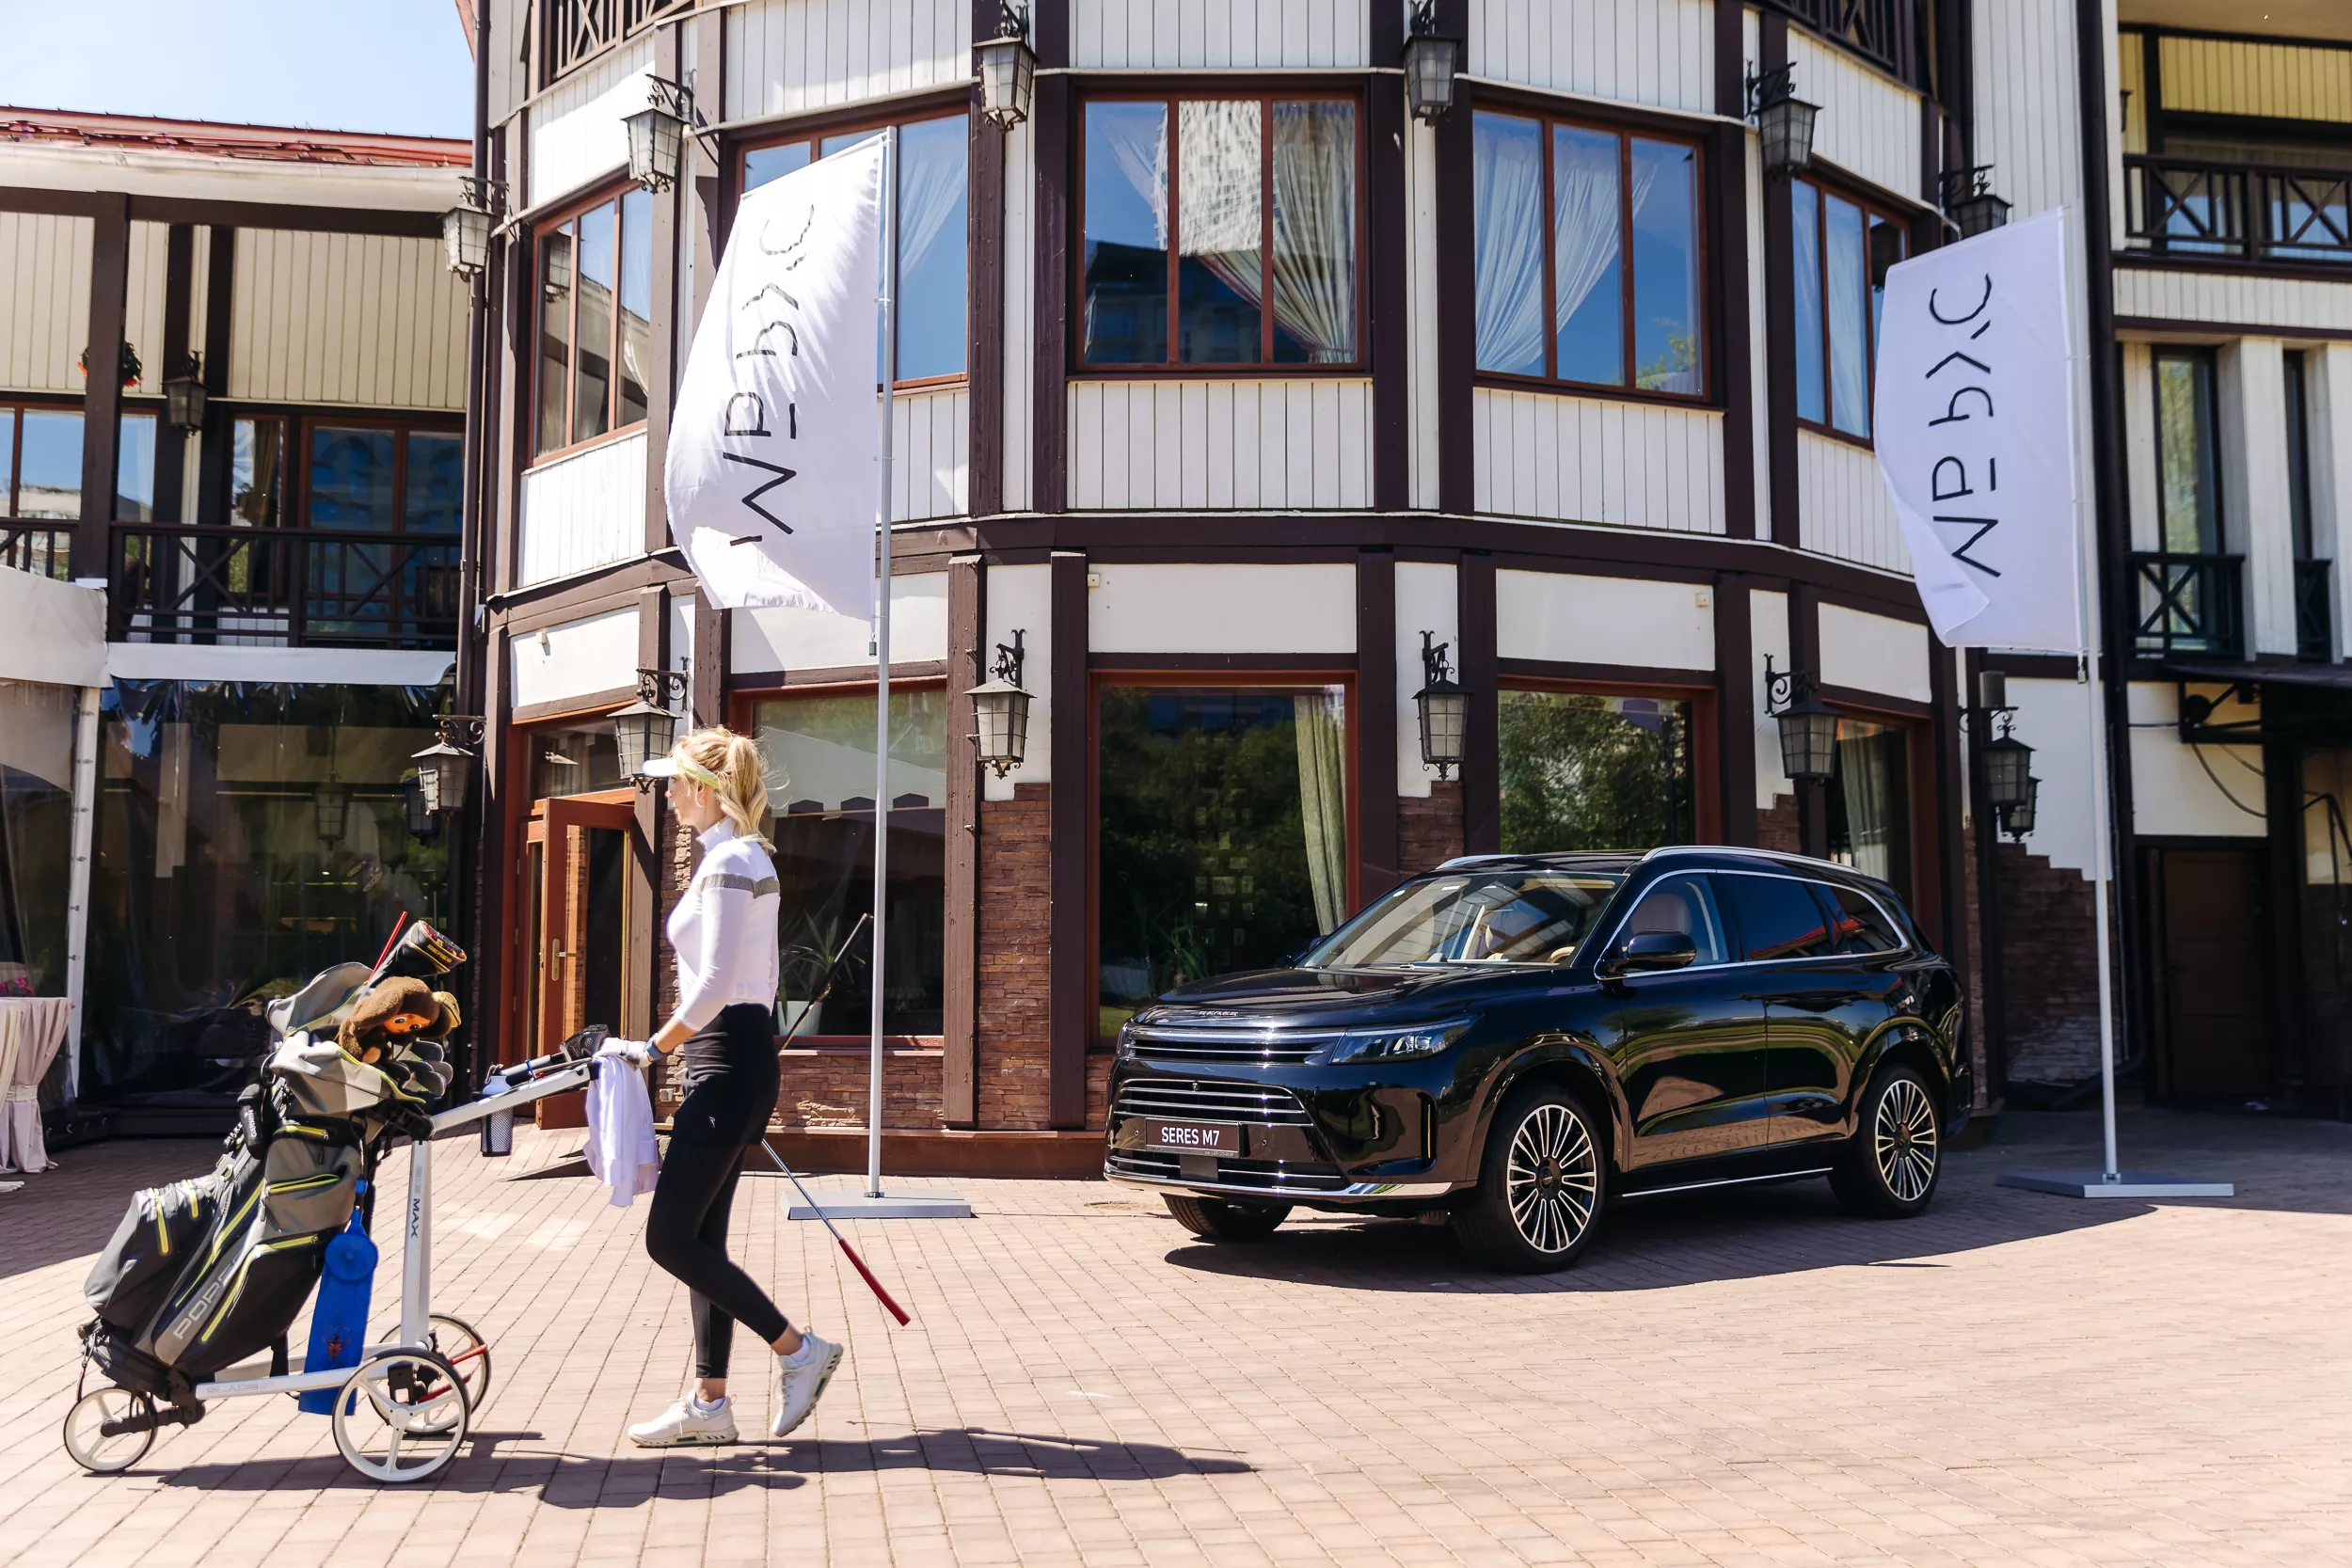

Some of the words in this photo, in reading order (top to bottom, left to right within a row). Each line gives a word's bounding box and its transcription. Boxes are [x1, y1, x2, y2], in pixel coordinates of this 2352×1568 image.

[248, 1110, 257, 1138] GARMIN
[1161, 1126, 1200, 1146] SERES
[1202, 1129, 1220, 1147] M7
[411, 1198, 421, 1239] MAX
